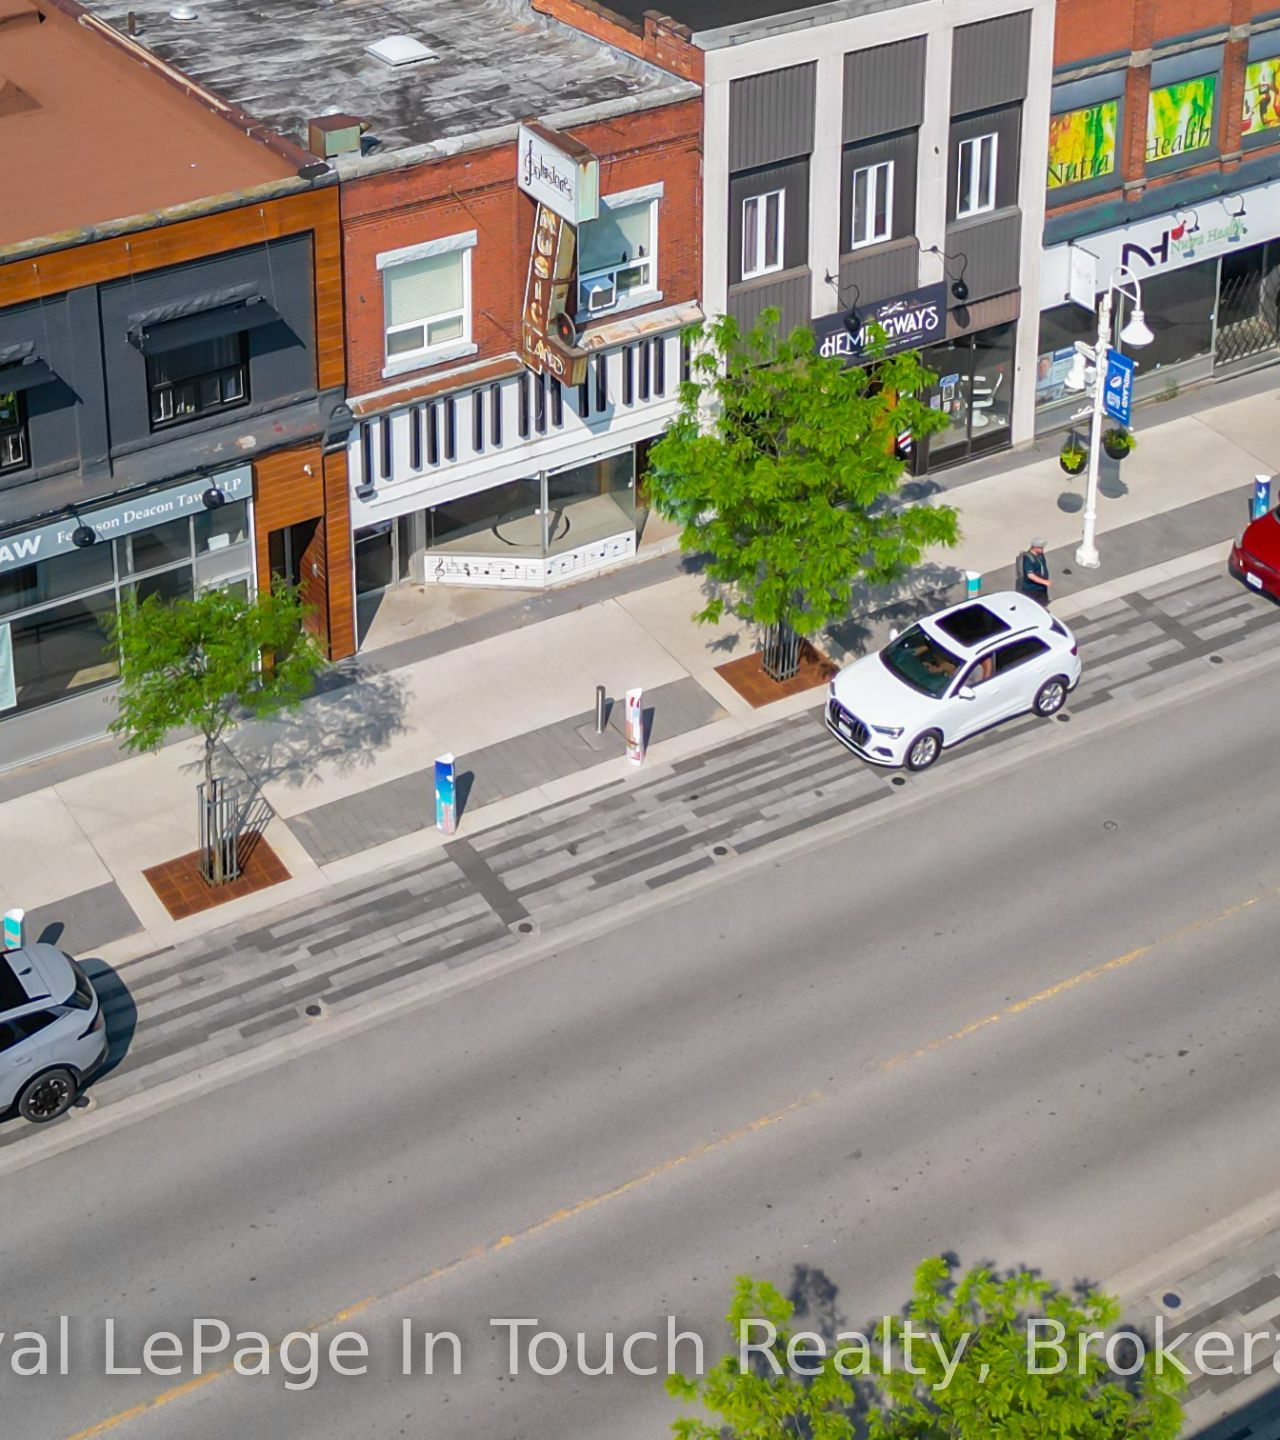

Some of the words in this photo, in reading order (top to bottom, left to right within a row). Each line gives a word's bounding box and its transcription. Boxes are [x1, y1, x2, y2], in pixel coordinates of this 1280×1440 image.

[1146, 114, 1210, 160] Health
[1047, 154, 1109, 187] Nutra
[530, 208, 557, 324] MUSIC
[526, 335, 564, 375] LAND
[58, 518, 119, 544] Feson
[123, 502, 174, 523] Deacon
